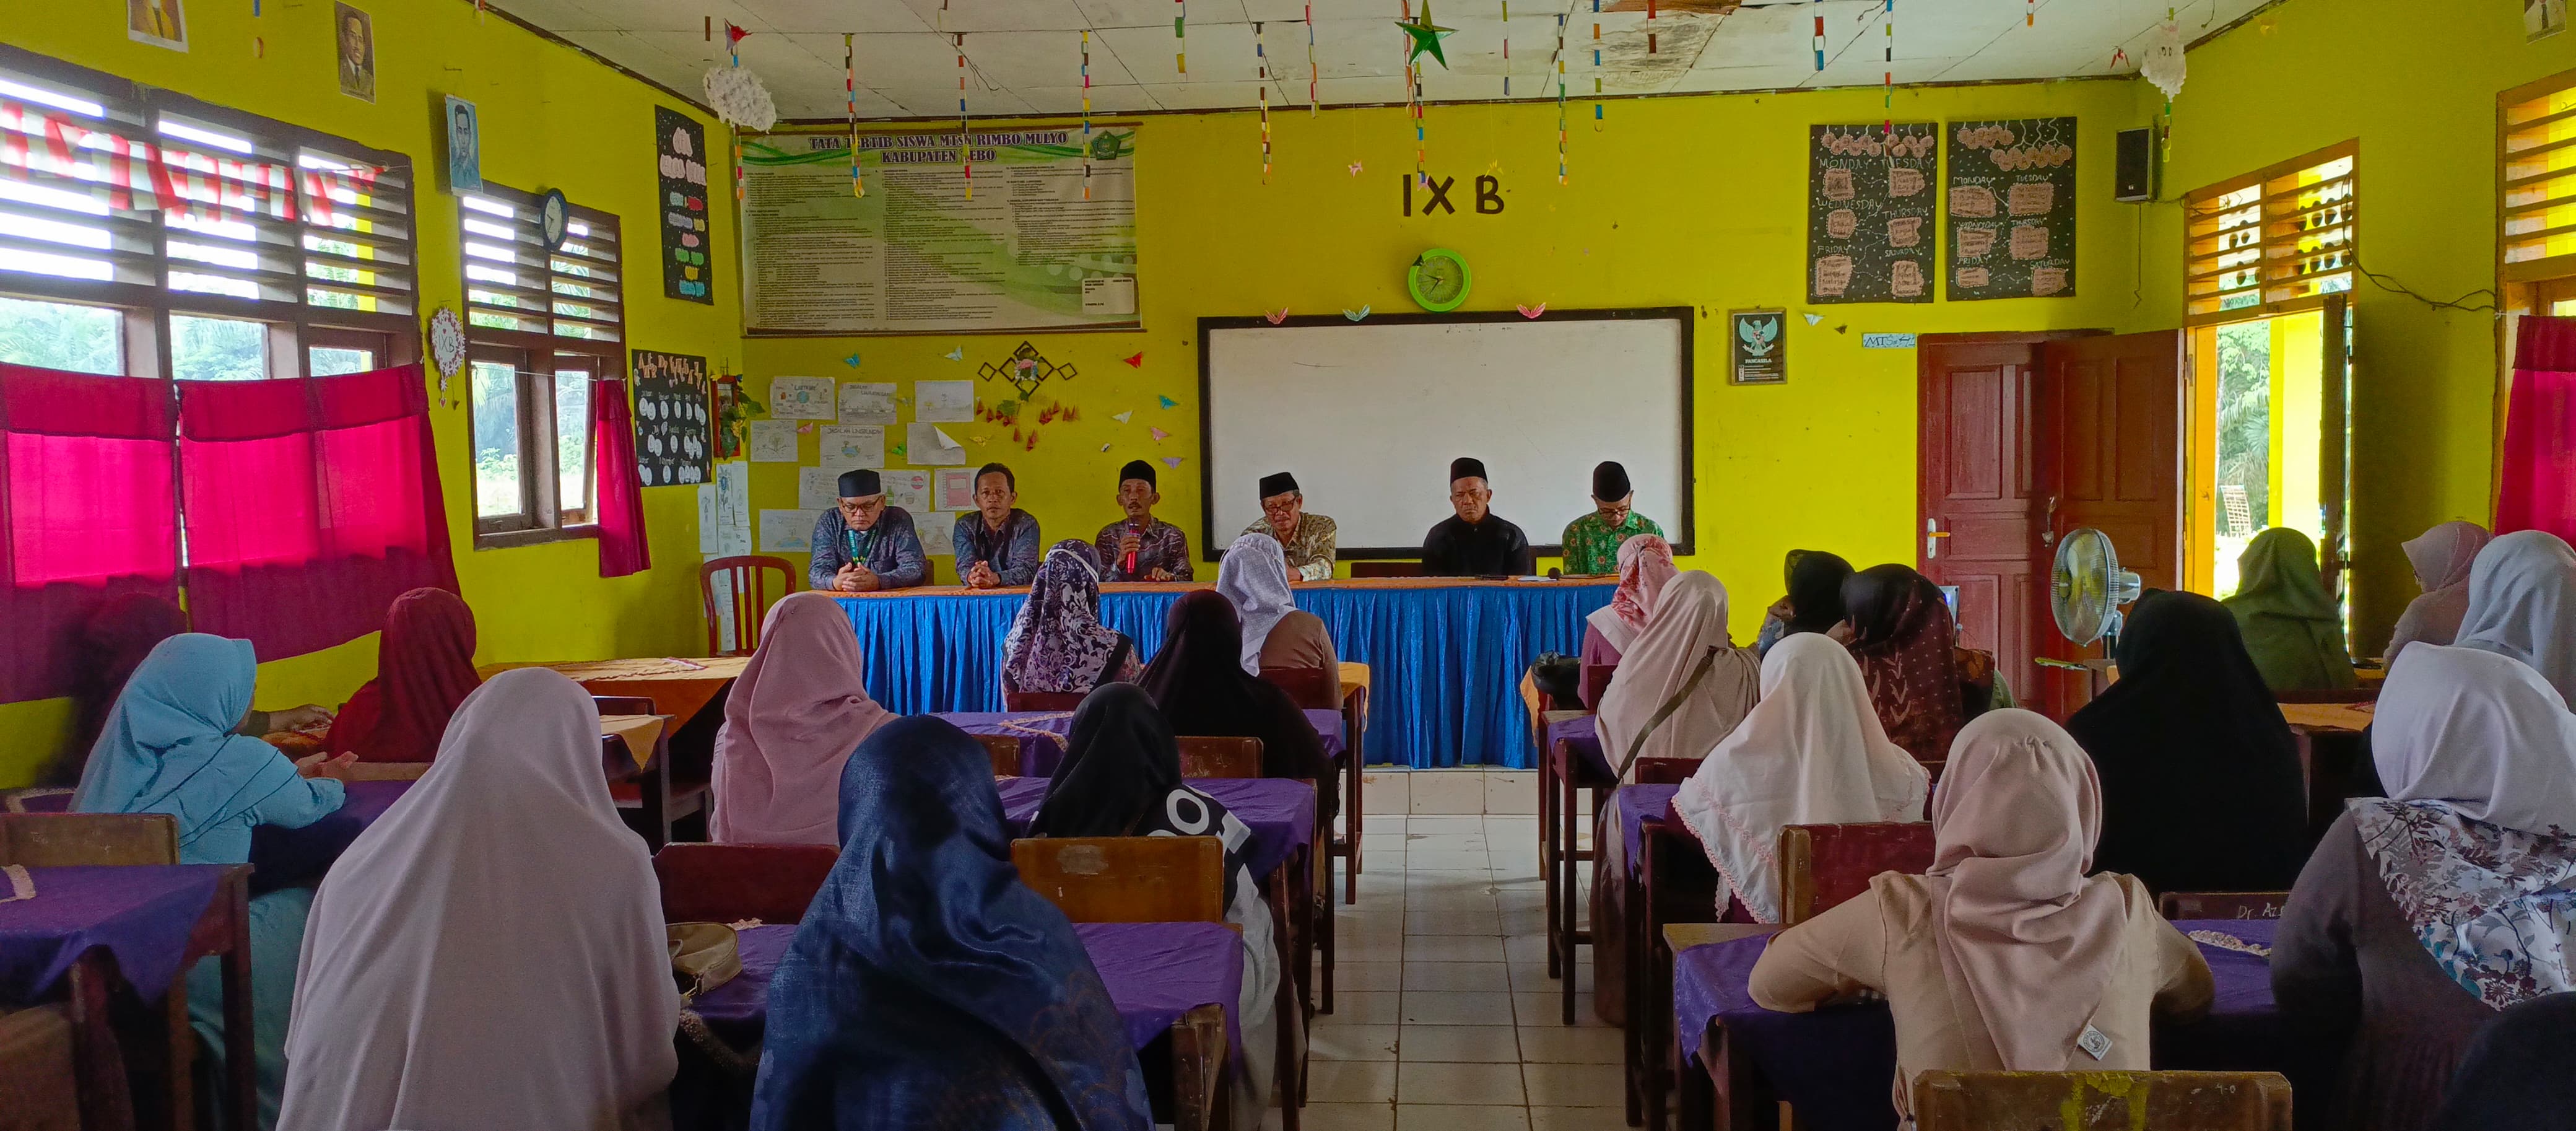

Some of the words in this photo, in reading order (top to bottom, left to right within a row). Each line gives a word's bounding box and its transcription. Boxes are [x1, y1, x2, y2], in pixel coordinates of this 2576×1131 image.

[810, 136, 842, 150] TATA
[897, 135, 936, 148] SISWA
[977, 133, 1021, 146] RIMBO
[1025, 131, 1069, 145] MULYO
[882, 150, 957, 164] KABUPATEN
[959, 148, 996, 162] EBO
[1819, 158, 1867, 169] MONDAY
[1953, 176, 1992, 186] MONDAY
[1476, 175, 1504, 214] B
[1817, 198, 1881, 210] WEDNESDAY
[1817, 245, 1849, 254] FRIDAY
